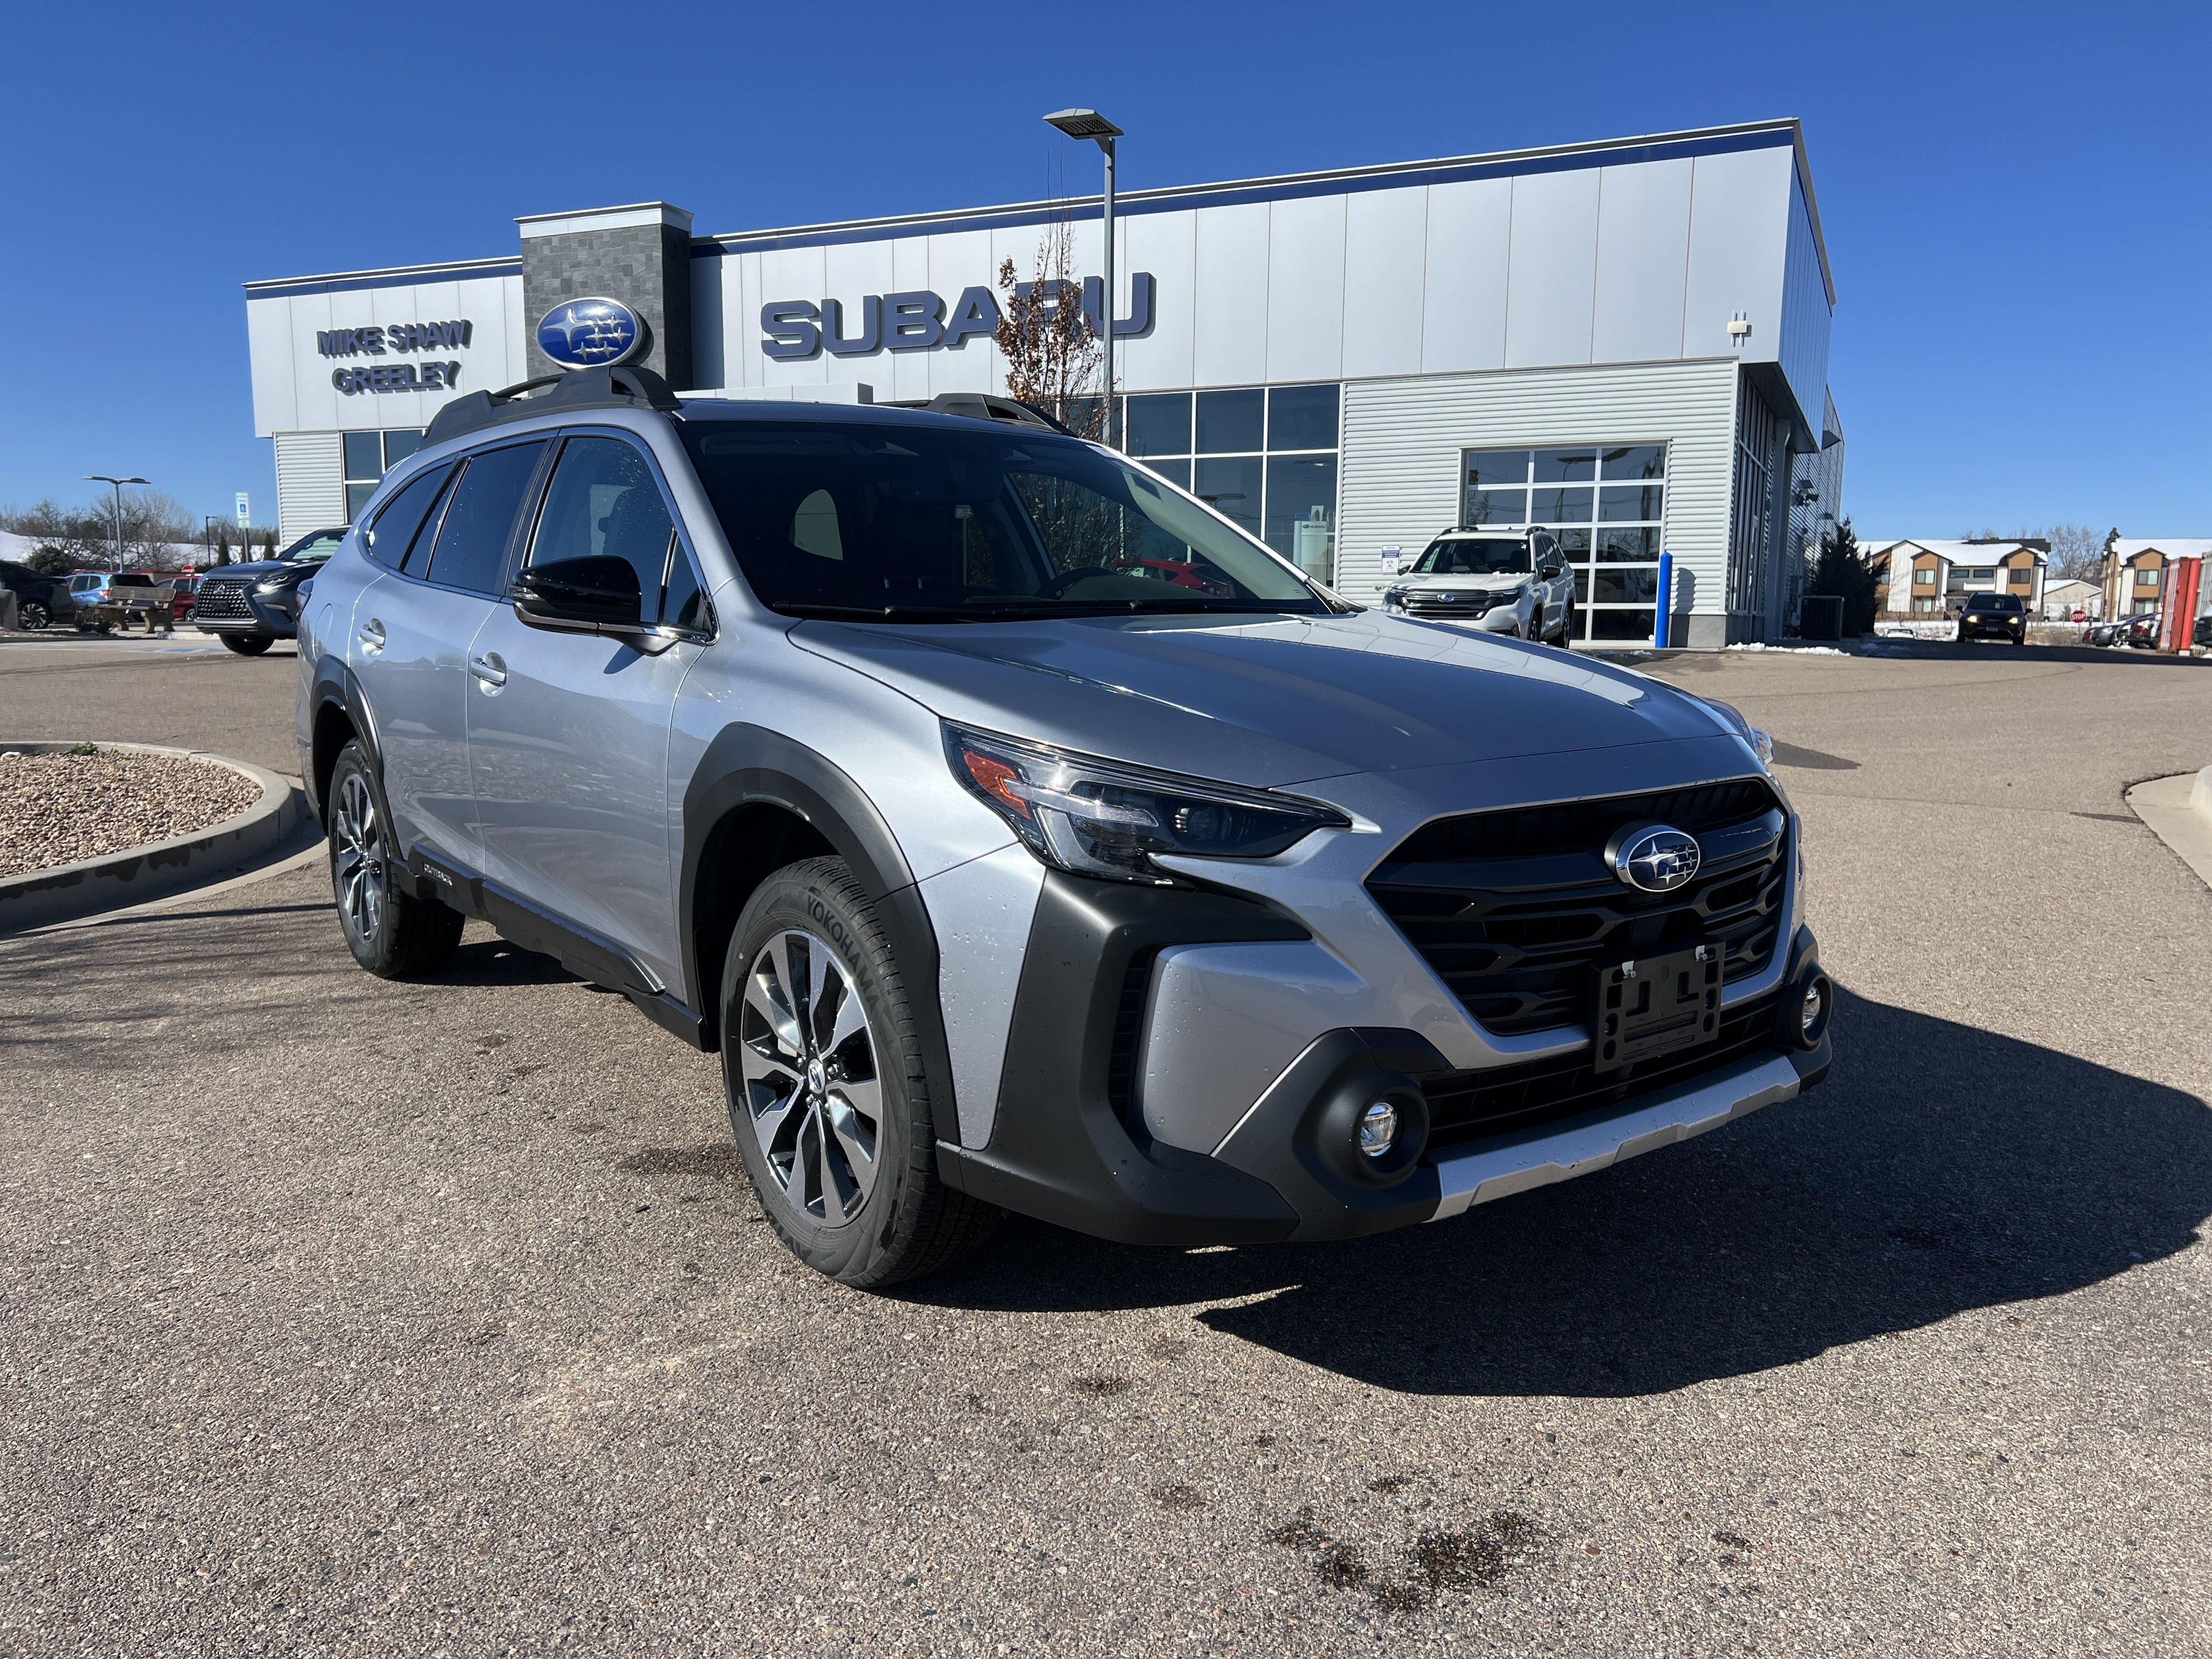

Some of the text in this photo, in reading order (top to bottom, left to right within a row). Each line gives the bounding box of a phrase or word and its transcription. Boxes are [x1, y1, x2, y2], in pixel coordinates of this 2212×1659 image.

[760, 272, 1156, 359] SUBARU
[317, 320, 473, 359] MIKE SHAW
[331, 360, 462, 396] GREELEY
[424, 864, 453, 887] OUTBACK
[808, 894, 878, 1012] YOKOHAMA
